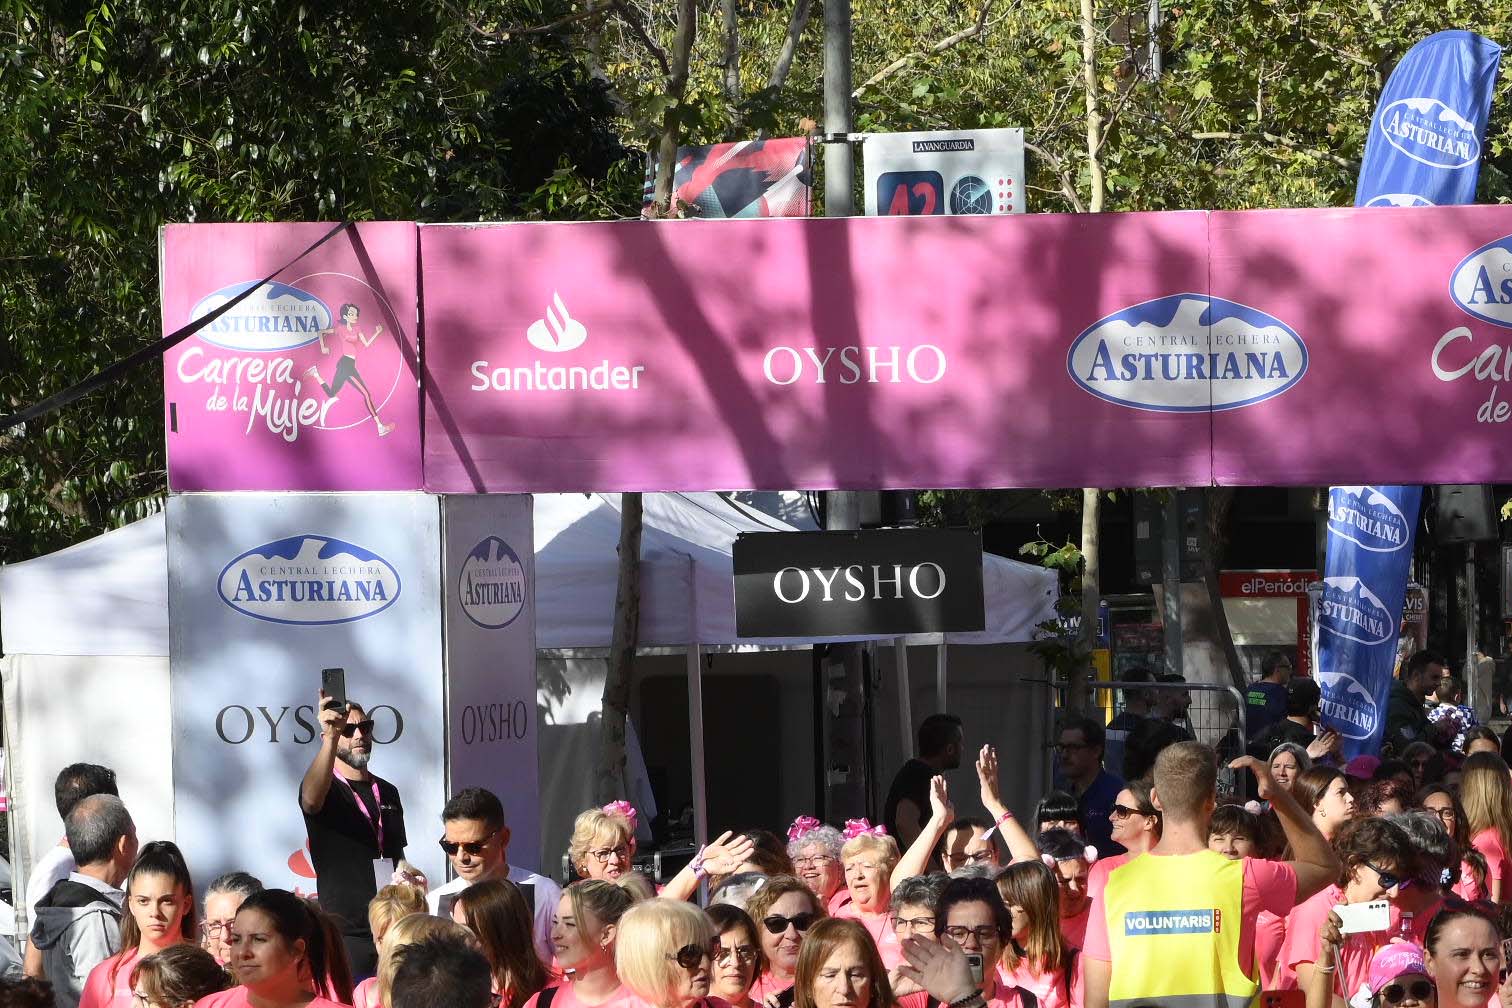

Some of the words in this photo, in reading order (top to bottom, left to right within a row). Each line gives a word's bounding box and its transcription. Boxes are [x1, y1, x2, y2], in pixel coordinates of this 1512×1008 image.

[1387, 110, 1470, 160] ASTURIAN
[1123, 335, 1198, 347] CENTRAL
[1206, 334, 1281, 346] LECHERA
[177, 346, 294, 385] Carrera
[471, 360, 645, 392] Santander
[762, 344, 948, 386] OYSHO
[1086, 339, 1290, 382] ASTURIANA
[206, 387, 228, 412] de
[232, 385, 248, 412] la
[246, 380, 340, 443] Mujer
[1476, 384, 1511, 424] de
[232, 568, 388, 602] ASTURIANA
[261, 566, 318, 576] CENTRAL
[324, 566, 382, 576] LECHERA
[465, 571, 522, 606] ASTURIANA
[773, 562, 947, 604] OYSHO
[1241, 577, 1309, 594] elPeriódi
[1322, 600, 1385, 638] STURIANA
[215, 704, 404, 745] OYSO
[461, 700, 528, 745] OYSHO
[1318, 697, 1372, 733] TURIANA
[1126, 915, 1212, 931] VOLUNTARIS
